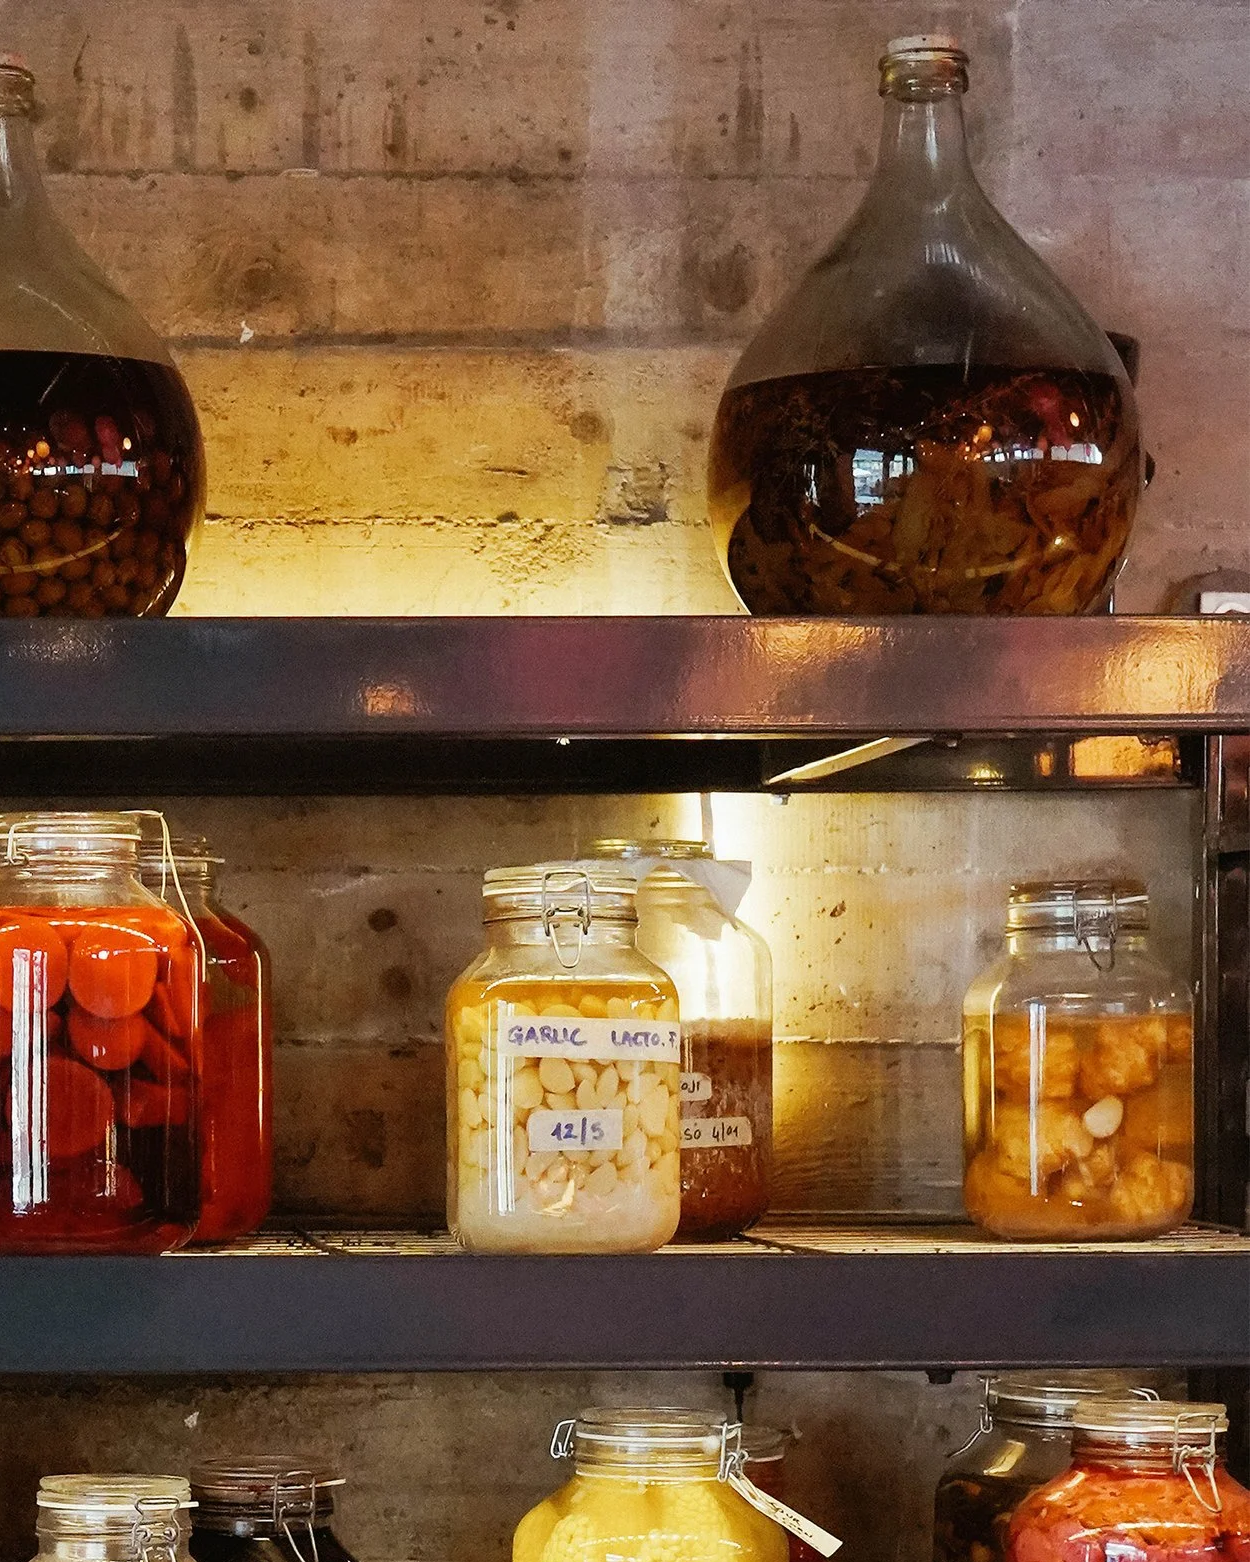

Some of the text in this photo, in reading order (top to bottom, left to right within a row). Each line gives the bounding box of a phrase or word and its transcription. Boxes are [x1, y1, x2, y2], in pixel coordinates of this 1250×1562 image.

[508, 1025, 587, 1046] GARLIC
[680, 1080, 700, 1093] OJI
[551, 1116, 605, 1145] 12/5
